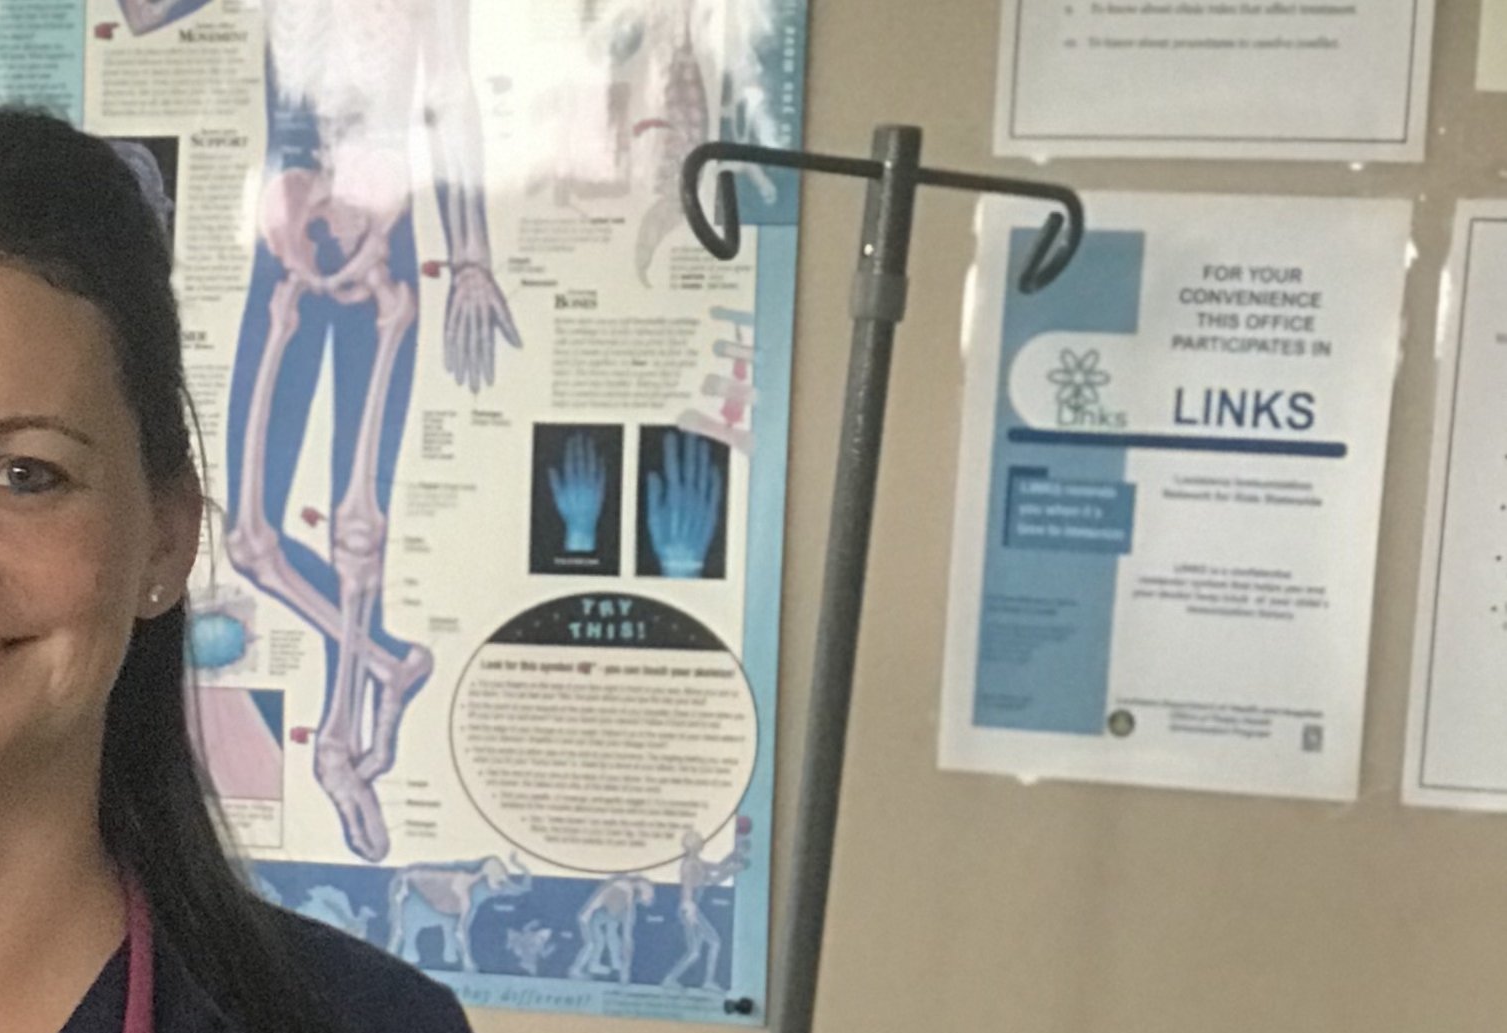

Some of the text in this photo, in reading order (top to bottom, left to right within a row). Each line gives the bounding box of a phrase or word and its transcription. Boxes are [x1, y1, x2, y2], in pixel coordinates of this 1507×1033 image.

[1203, 265, 1302, 283] FOR YOUR
[1180, 287, 1323, 308] CONVENIENCE
[1197, 312, 1315, 332] THIS OFFICE
[1171, 334, 1332, 356] PARTICIPATES IN
[1174, 387, 1316, 431] LINKS
[581, 597, 632, 617] TRY
[568, 620, 645, 640] THIS!
